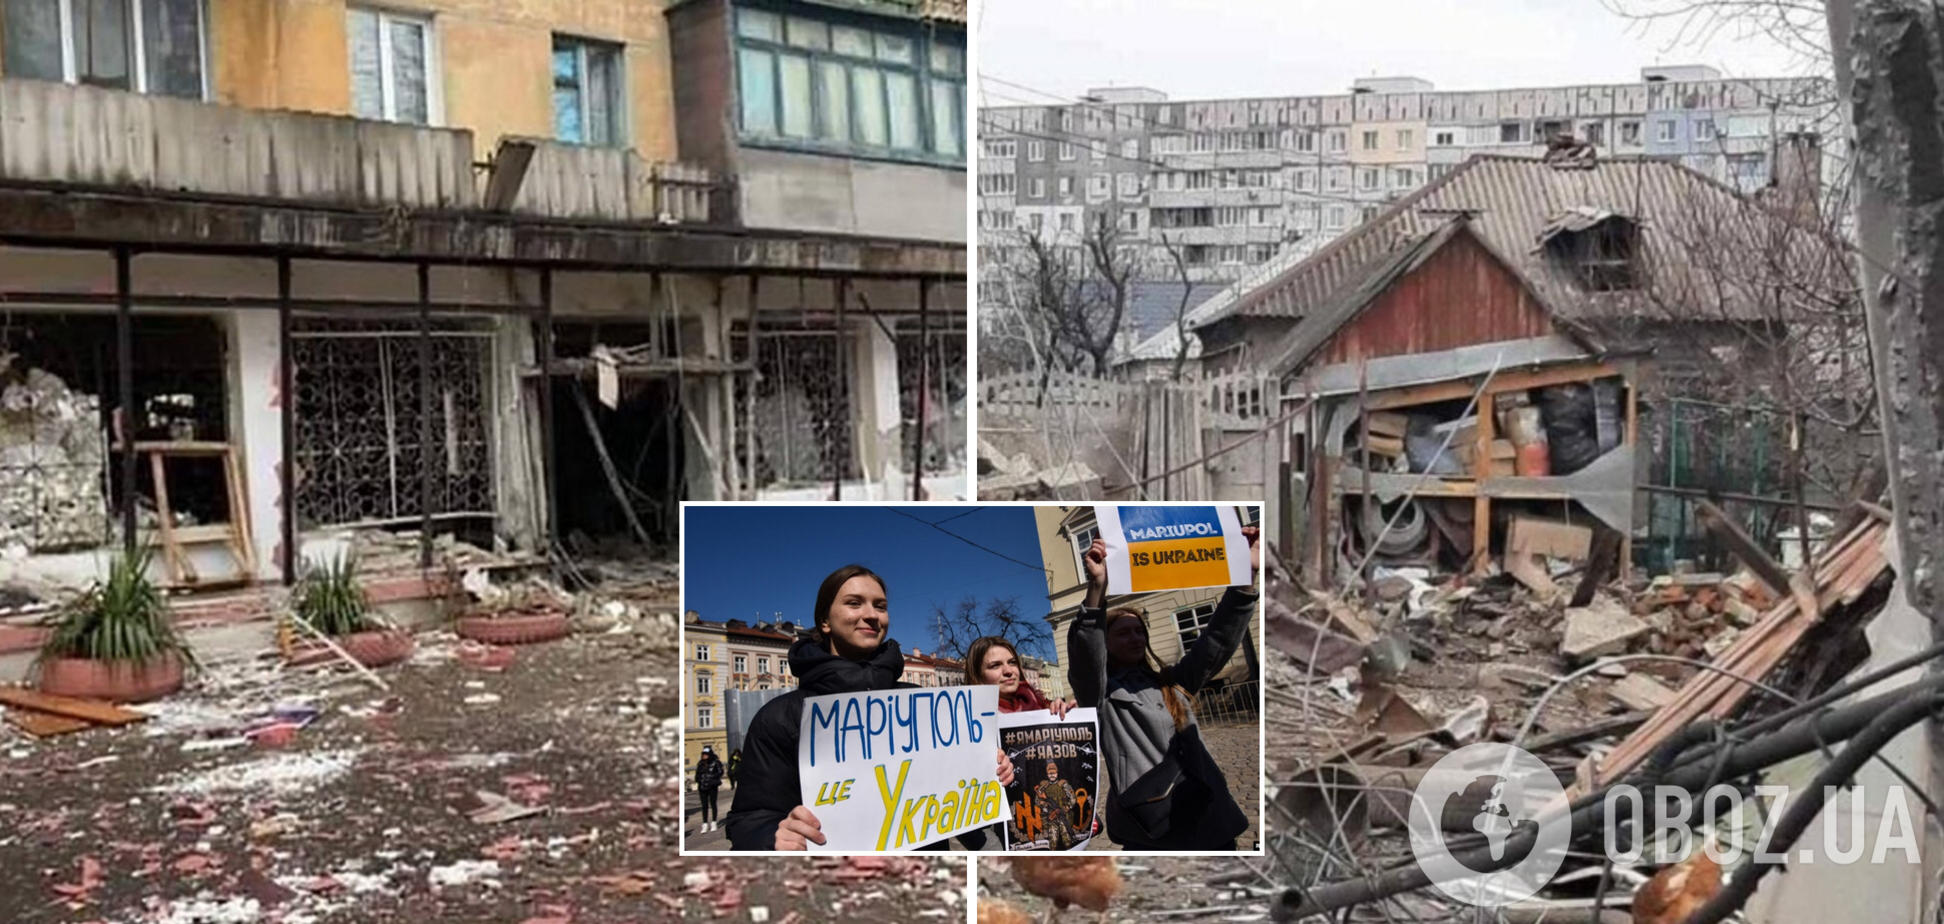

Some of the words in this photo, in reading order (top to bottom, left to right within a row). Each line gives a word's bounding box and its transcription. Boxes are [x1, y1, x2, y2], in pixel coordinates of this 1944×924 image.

[1130, 523, 1218, 540] MARIUPOL
[1132, 552, 1149, 566] IS
[1153, 547, 1225, 565] UKRAINE
[1005, 727, 1093, 745] #ЯМАРІУПОЛЬ
[1025, 743, 1077, 760] #ЯАЗОВ
[874, 759, 1001, 851] Україна
